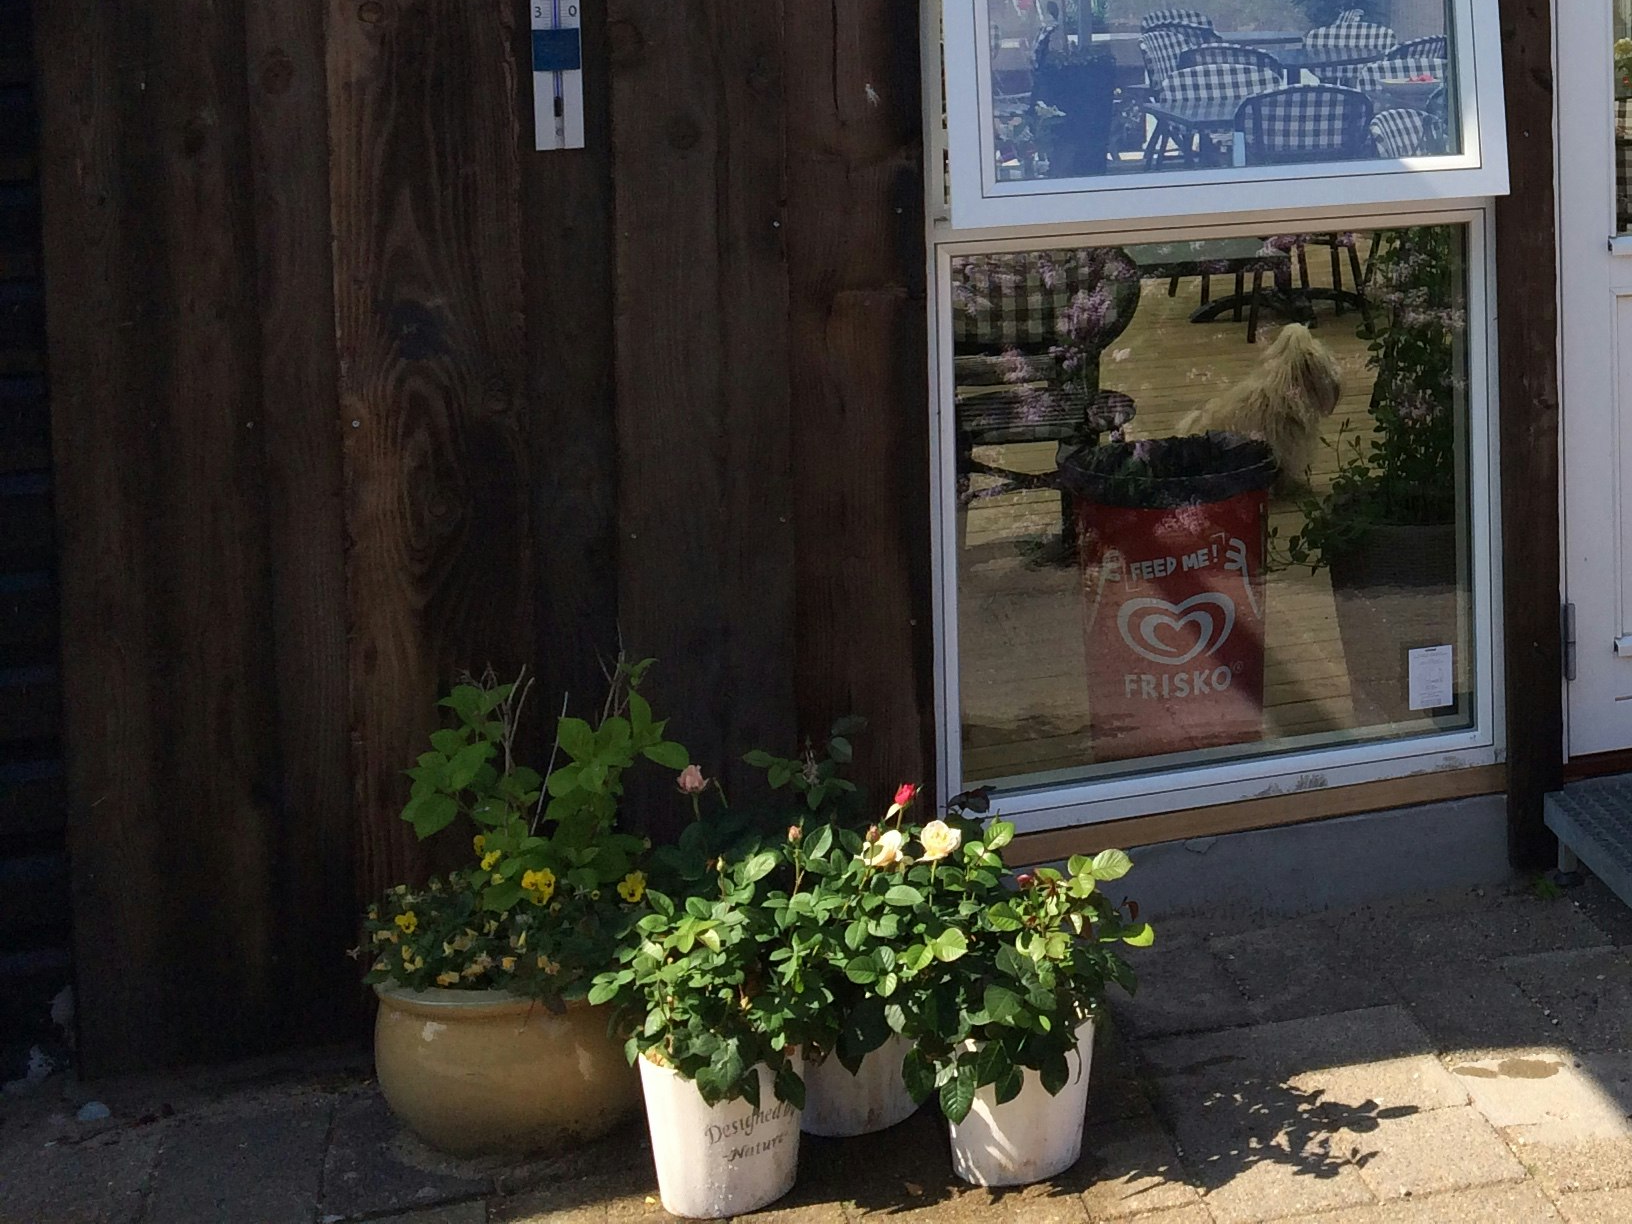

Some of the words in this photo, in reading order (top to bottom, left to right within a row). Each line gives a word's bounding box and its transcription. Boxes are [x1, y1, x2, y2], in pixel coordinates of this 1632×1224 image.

[1130, 556, 1177, 581] FEED
[1182, 544, 1218, 572] ME!
[1125, 665, 1232, 699] FRISKO
